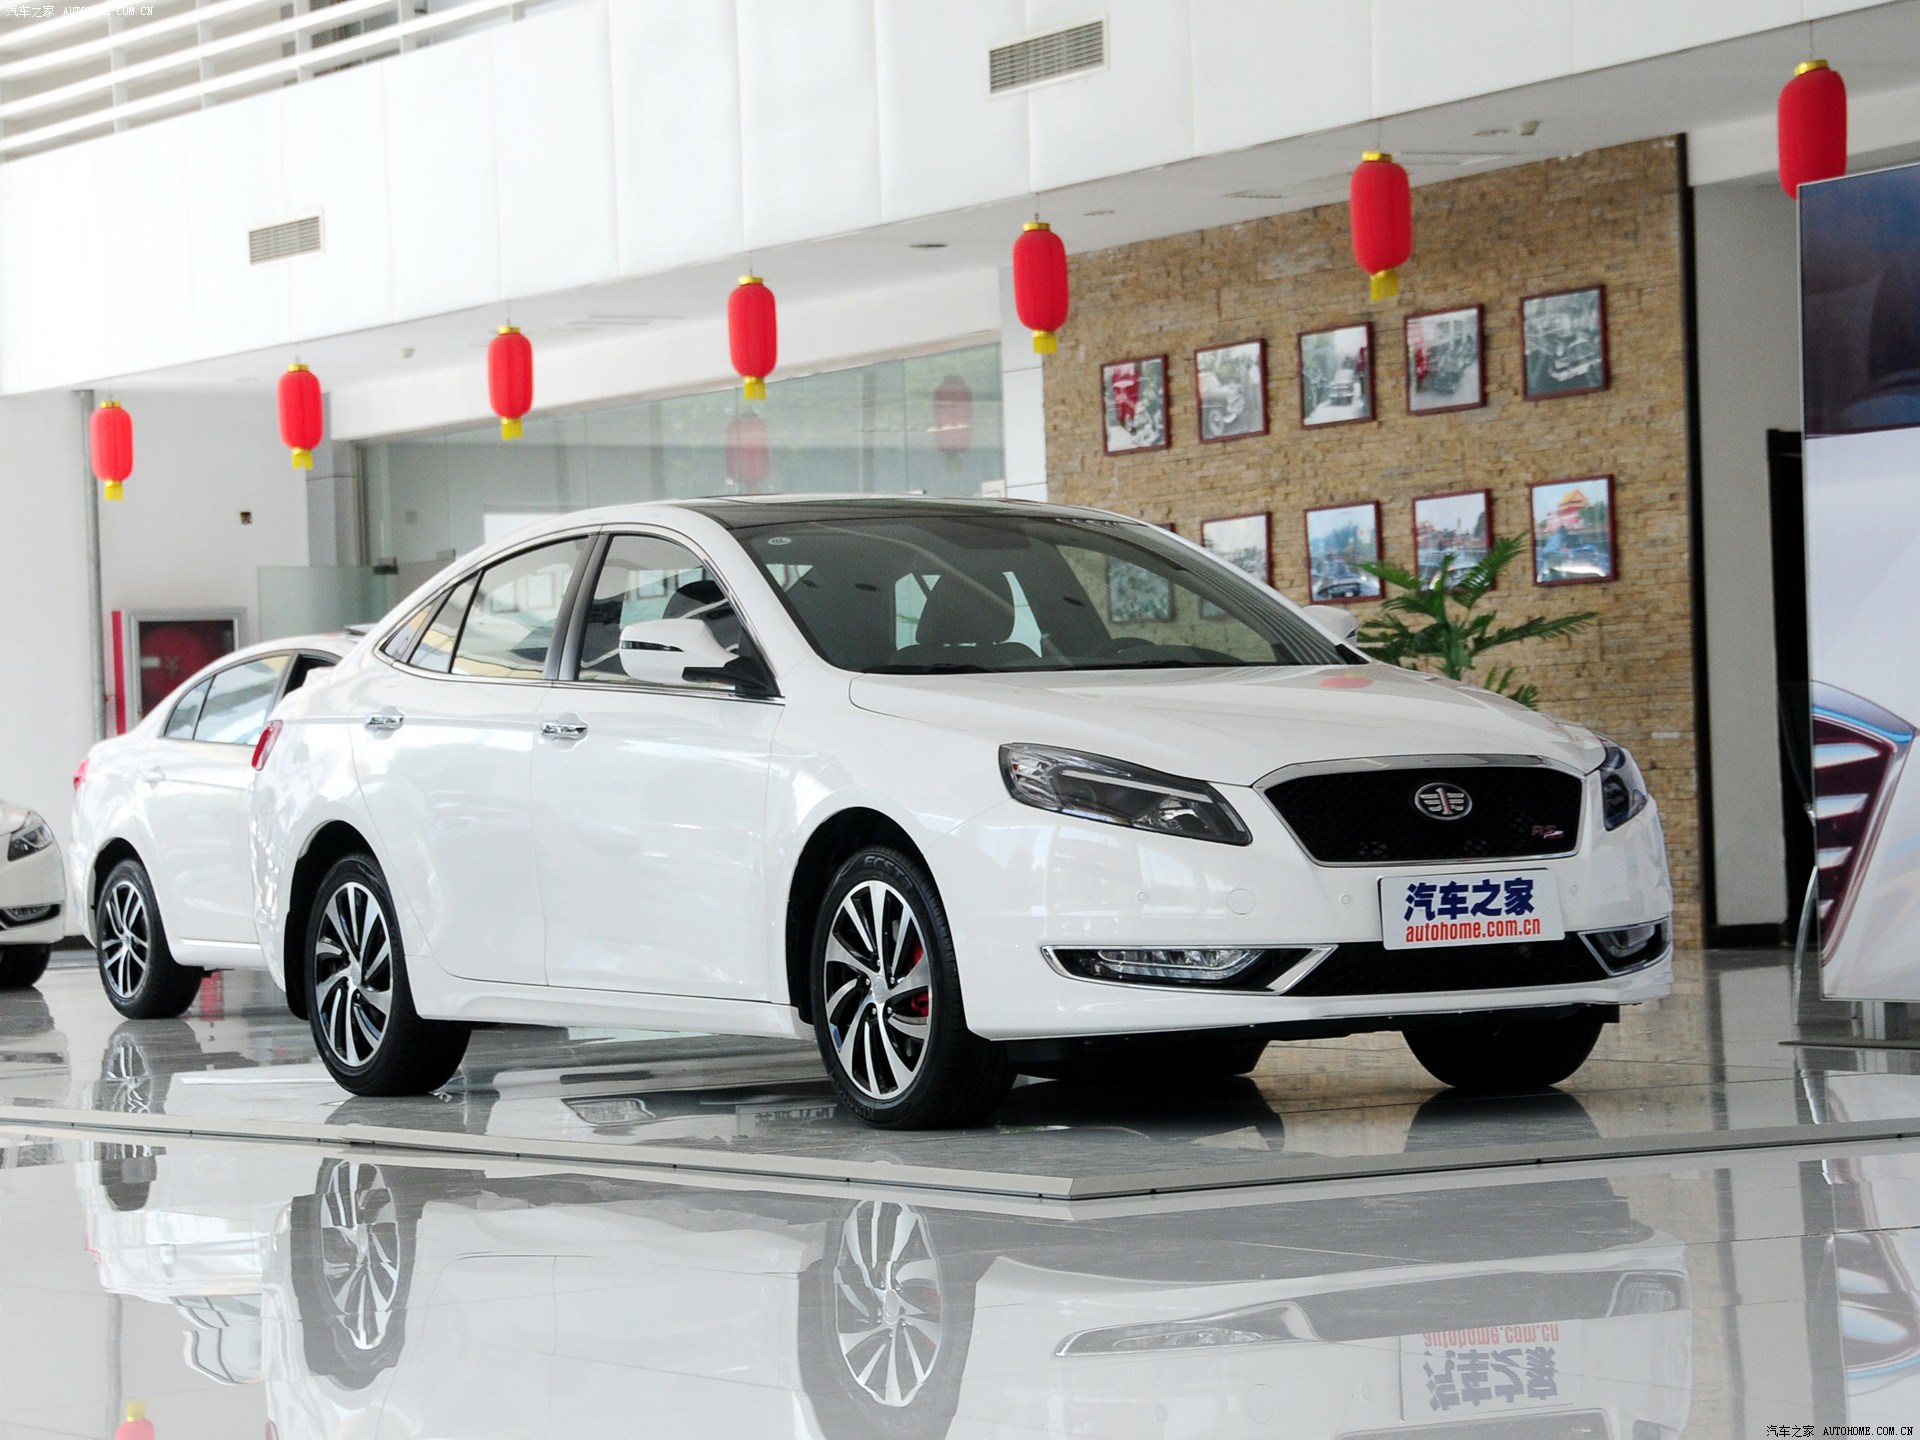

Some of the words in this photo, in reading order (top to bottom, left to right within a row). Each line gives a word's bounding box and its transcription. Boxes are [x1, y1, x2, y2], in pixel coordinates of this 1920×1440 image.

[1403, 877, 1535, 922] 汽车之家
[1405, 918, 1541, 943] autohome.com.cn
